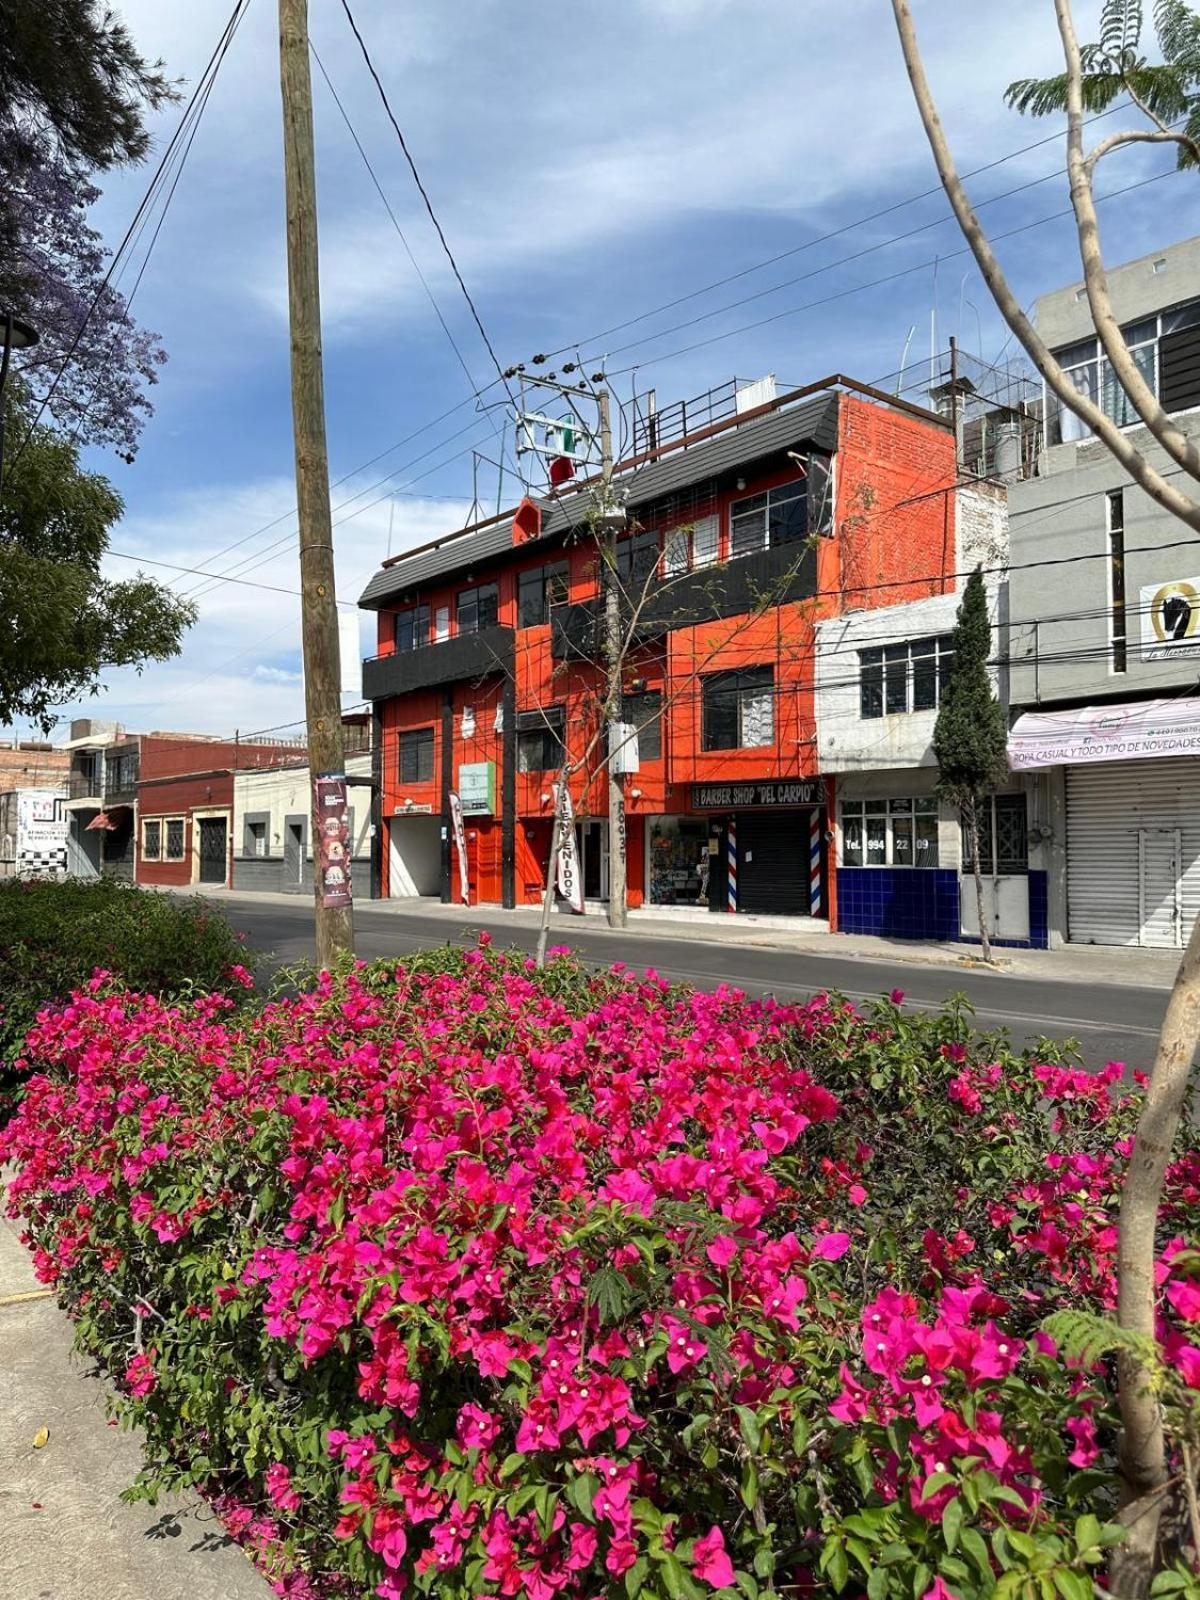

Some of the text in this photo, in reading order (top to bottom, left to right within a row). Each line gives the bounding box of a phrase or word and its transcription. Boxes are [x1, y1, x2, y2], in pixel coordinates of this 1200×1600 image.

[1036, 748, 1069, 761] CASUAL
[1070, 748, 1077, 757] Y
[1077, 745, 1104, 757] TODO
[1105, 743, 1127, 755] TIPO
[1127, 741, 1142, 753] DE
[1143, 736, 1200, 751] NOVEDADES
[701, 788, 732, 805] BARBER
[733, 786, 755, 804] SHOP
[560, 791, 574, 898] BIENVENIDOS
[867, 839, 885, 850] 994
[896, 839, 909, 850] 22
[916, 838, 929, 850] 09
